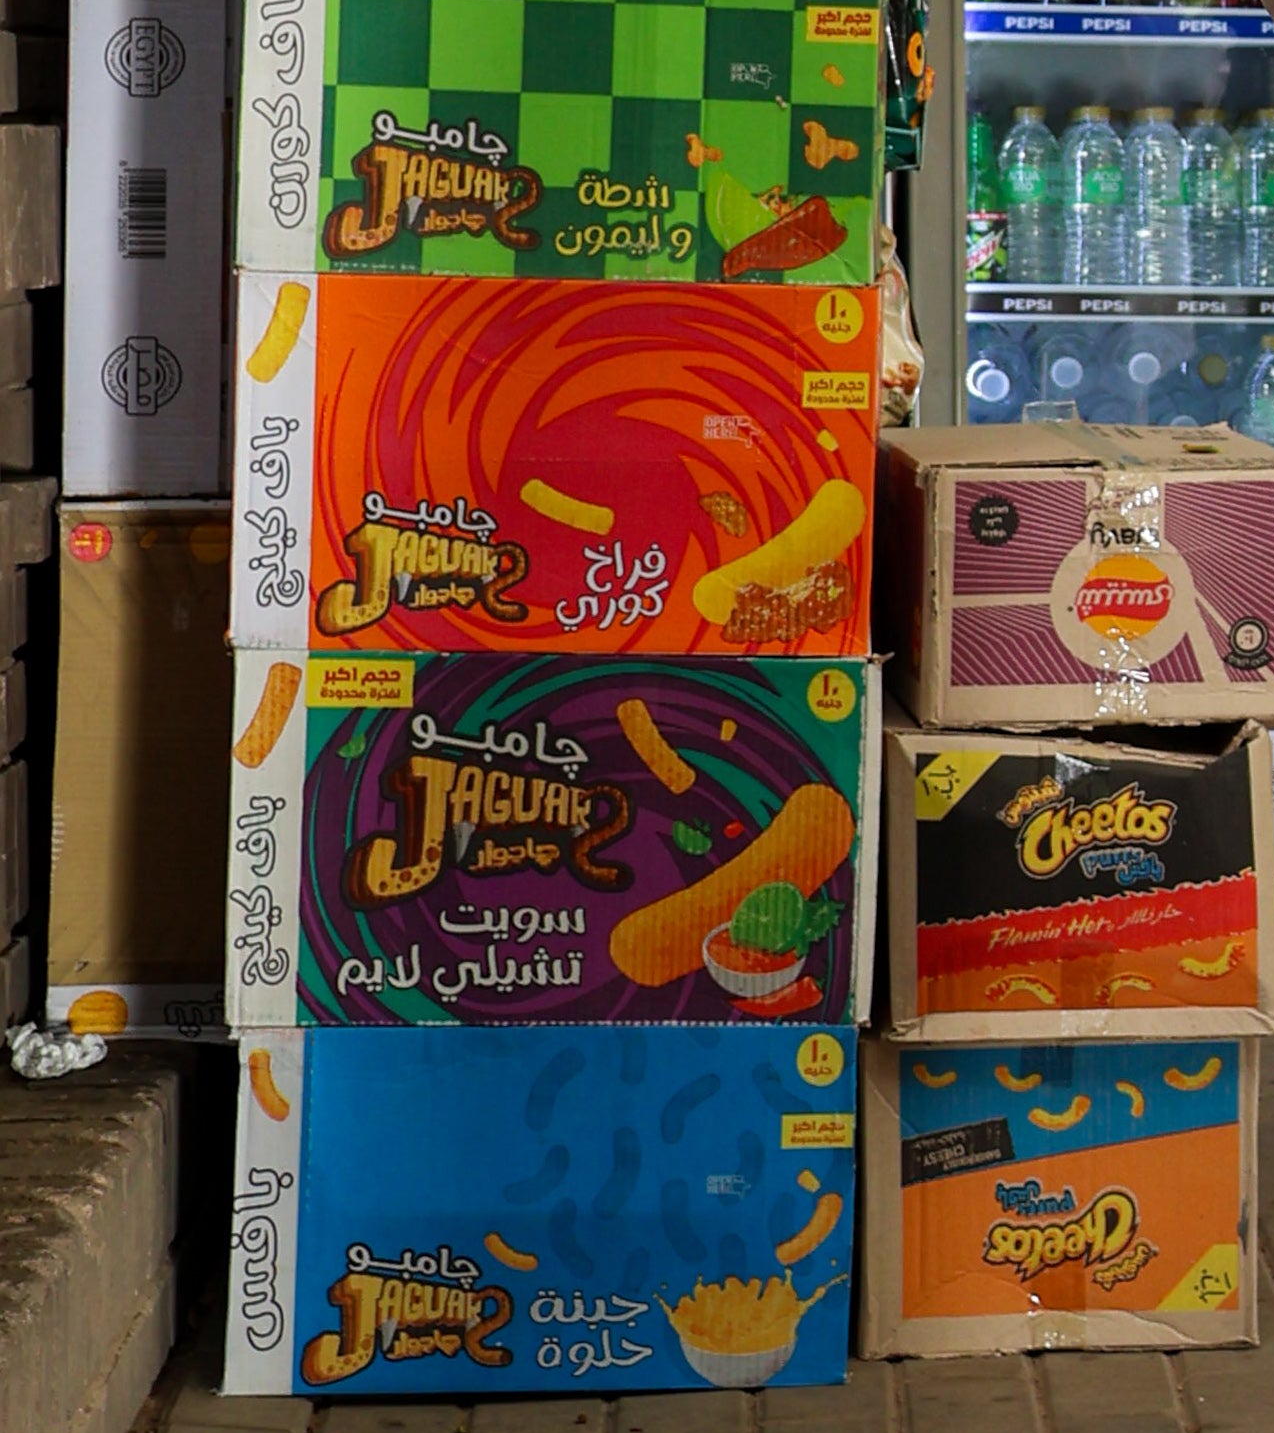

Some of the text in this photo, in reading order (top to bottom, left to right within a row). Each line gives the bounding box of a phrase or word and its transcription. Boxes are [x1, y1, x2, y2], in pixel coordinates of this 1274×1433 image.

[133, 24, 159, 94] EGYPT
[1003, 297, 1053, 312] PEPSI
[585, 539, 668, 591] فراخ
[1016, 781, 1177, 880] Cheetos
[438, 901, 587, 943] سويت
[984, 1190, 1139, 1283] Cheetos
[536, 1334, 653, 1376] حلوة
